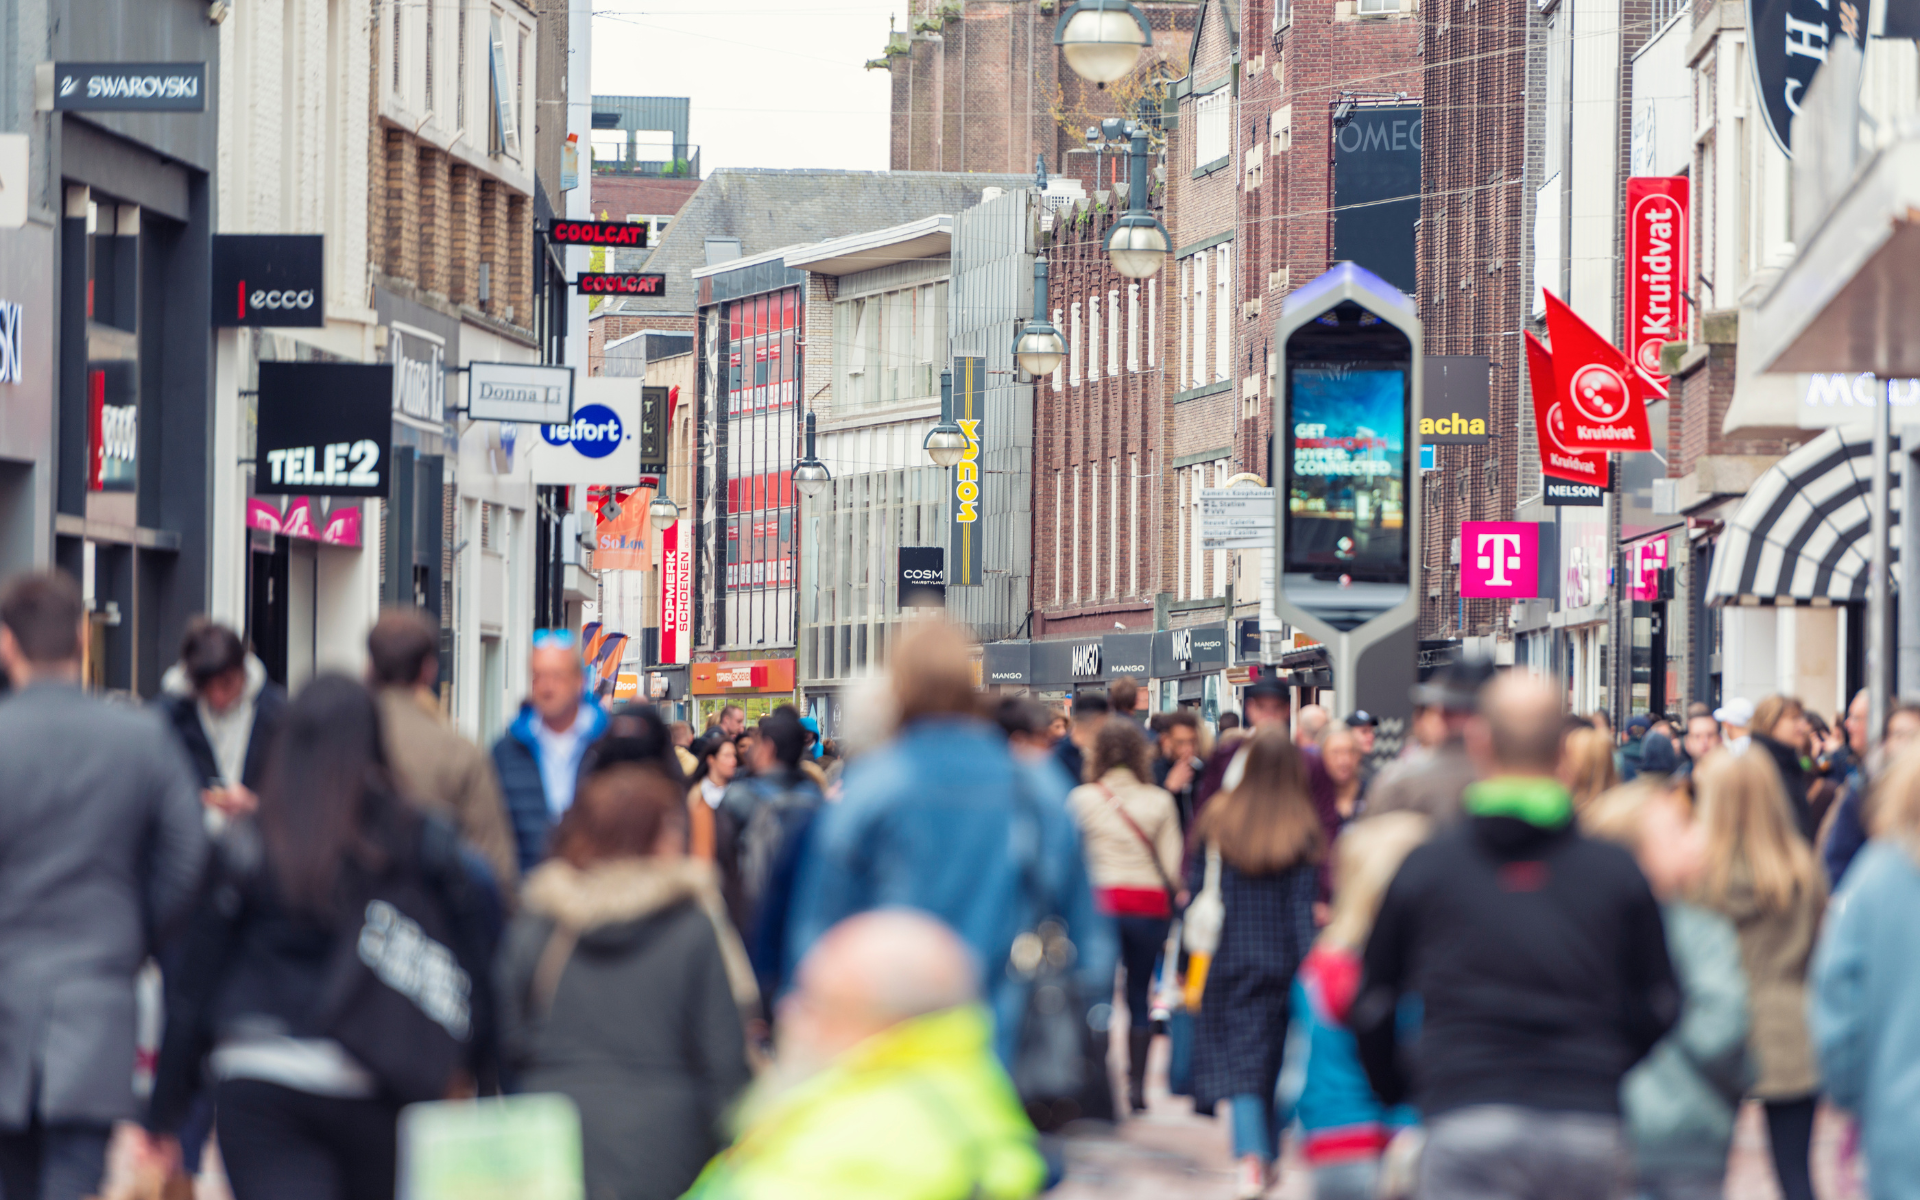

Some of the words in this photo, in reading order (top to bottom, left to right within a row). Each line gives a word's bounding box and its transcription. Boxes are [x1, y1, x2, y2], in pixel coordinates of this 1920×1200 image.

[86, 75, 198, 98] SWAROVSKI
[555, 223, 641, 244] COOLCAT
[1642, 208, 1672, 334] Kruidvat
[582, 276, 658, 293] COOLCAT
[250, 289, 314, 310] ecco
[479, 382, 538, 402] Donna
[544, 385, 562, 405] Li
[1294, 423, 1327, 440] GET
[1419, 412, 1486, 435] acha
[1577, 425, 1637, 441] Kruidvat
[267, 439, 380, 488] TELE2
[1294, 460, 1393, 477] CONNECTED
[1550, 453, 1596, 474] Kruidvat
[1548, 485, 1600, 498] NELSON
[1477, 534, 1521, 587] T
[664, 550, 676, 633] TOPMERK
[679, 551, 690, 632] SCHOENEN
[1194, 641, 1222, 649] MANGO
[1072, 643, 1099, 677] MANGO
[1111, 664, 1146, 673] MANGO
[991, 672, 1023, 680] MANGO
